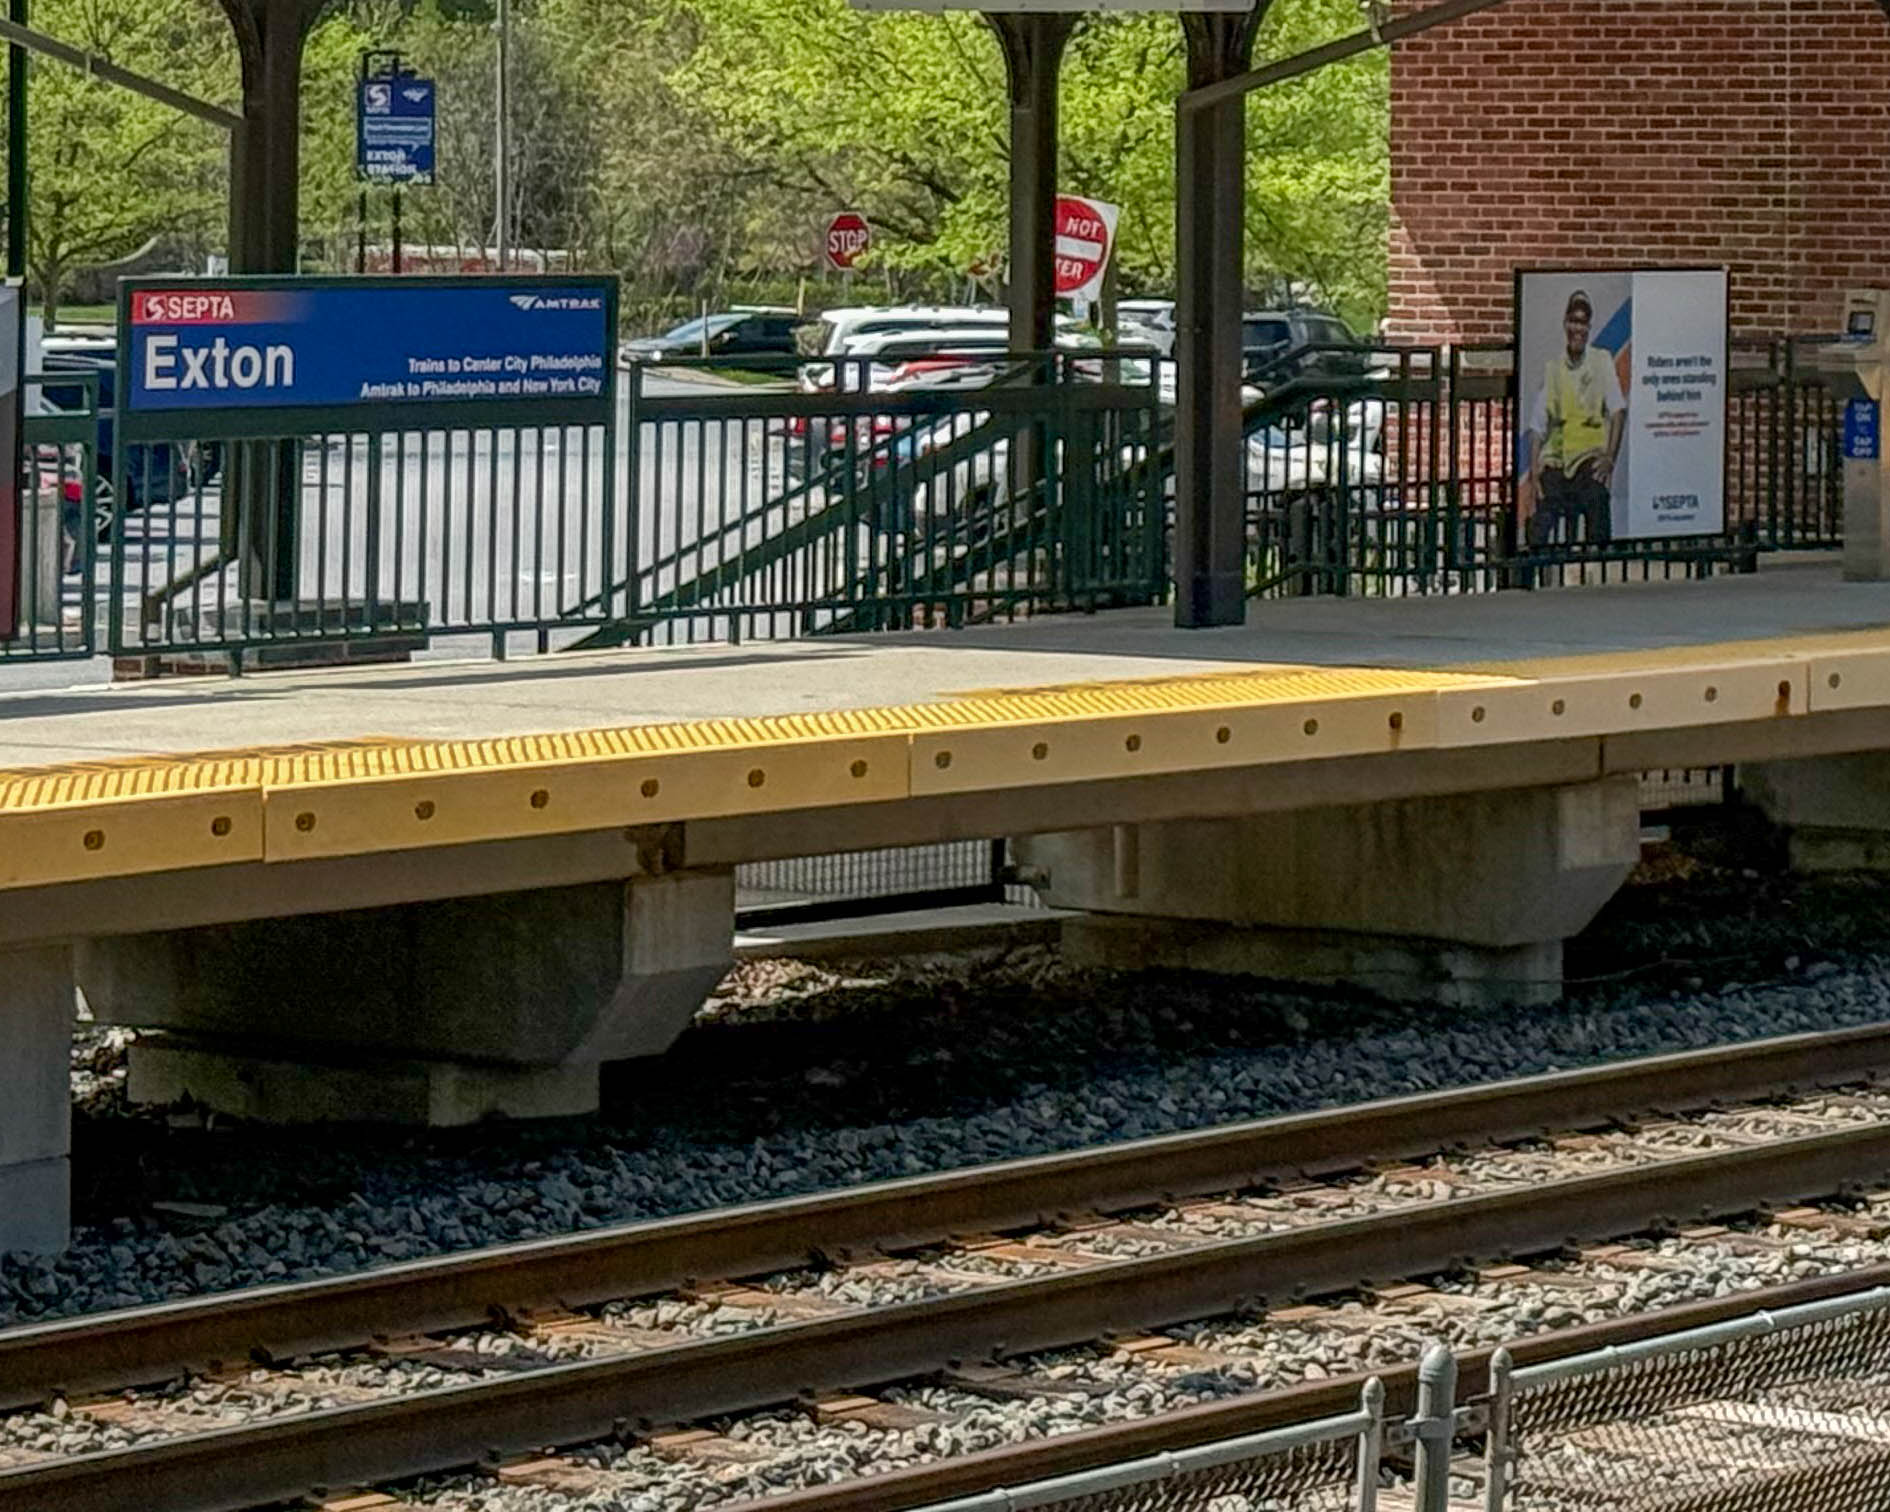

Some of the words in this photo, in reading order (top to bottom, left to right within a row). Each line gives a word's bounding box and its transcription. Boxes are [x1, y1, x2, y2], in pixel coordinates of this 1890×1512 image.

[1065, 216, 1101, 240] NOT
[829, 229, 867, 254] STOP
[1055, 257, 1083, 281] TER
[168, 295, 234, 320] SEPTA
[534, 297, 602, 310] AMTRAK
[144, 334, 295, 390] Exton
[408, 357, 446, 374] Trains
[447, 357, 461, 373] to
[463, 355, 502, 373] Center
[504, 354, 528, 375] City
[530, 354, 602, 373] Philadelphia
[360, 381, 405, 398] Amtrak
[407, 382, 421, 397] to
[422, 379, 496, 399] Philadelphia
[498, 378, 521, 394] and
[523, 377, 549, 393] New
[549, 376, 576, 393] York
[577, 375, 602, 395] City
